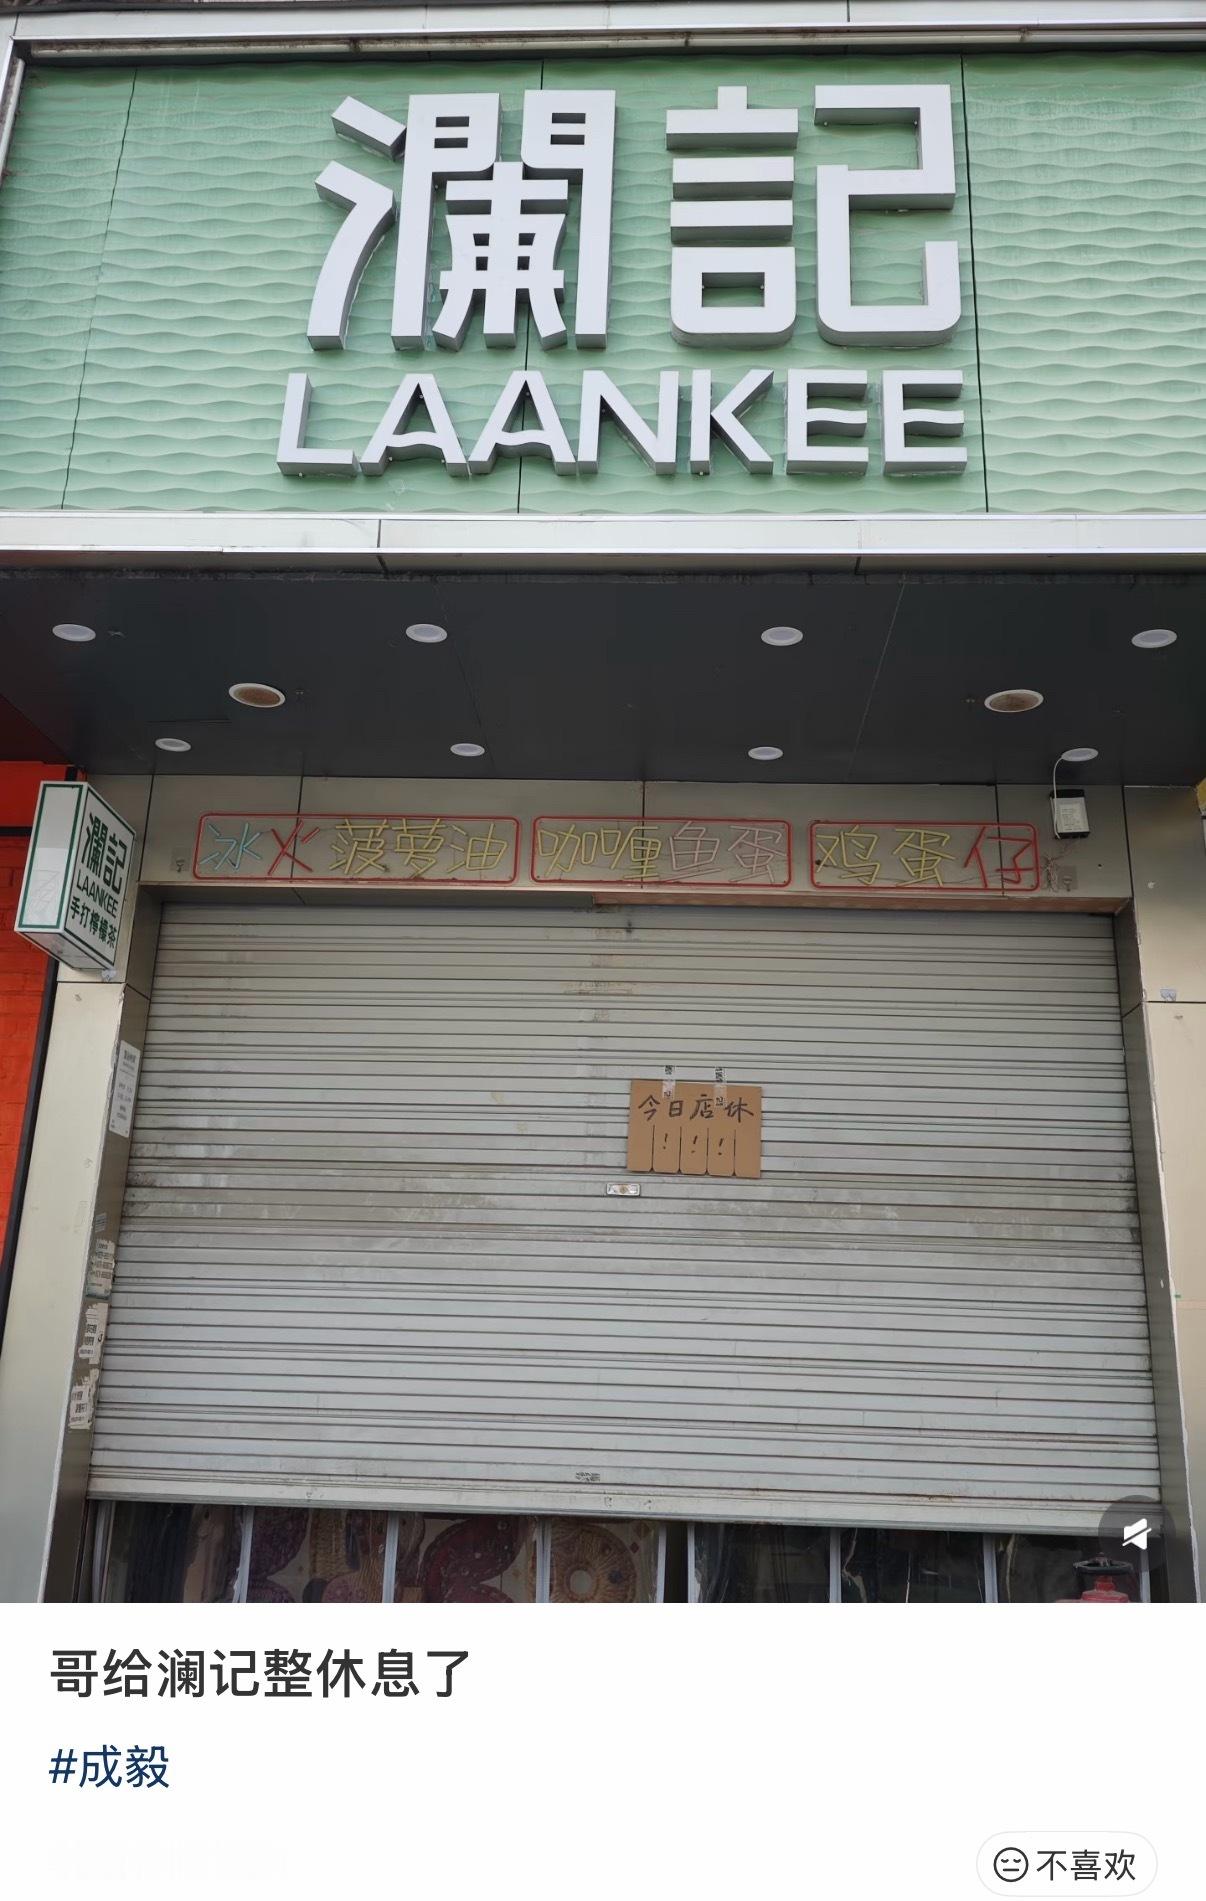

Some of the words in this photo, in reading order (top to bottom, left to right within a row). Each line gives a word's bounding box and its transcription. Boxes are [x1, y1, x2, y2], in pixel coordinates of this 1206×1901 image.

[307, 85, 962, 348] 瀾記
[277, 369, 967, 476] LAANKEE
[82, 813, 127, 895] 瀾記
[199, 817, 508, 877] 冰火菠萝油
[536, 820, 787, 884] 咖喱鱼蛋
[815, 824, 1035, 888] 鸡蛋仔
[70, 896, 118, 949] 手打檸檬茶
[76, 869, 119, 919] LAANKEE
[637, 1094, 755, 1123] 今日店休
